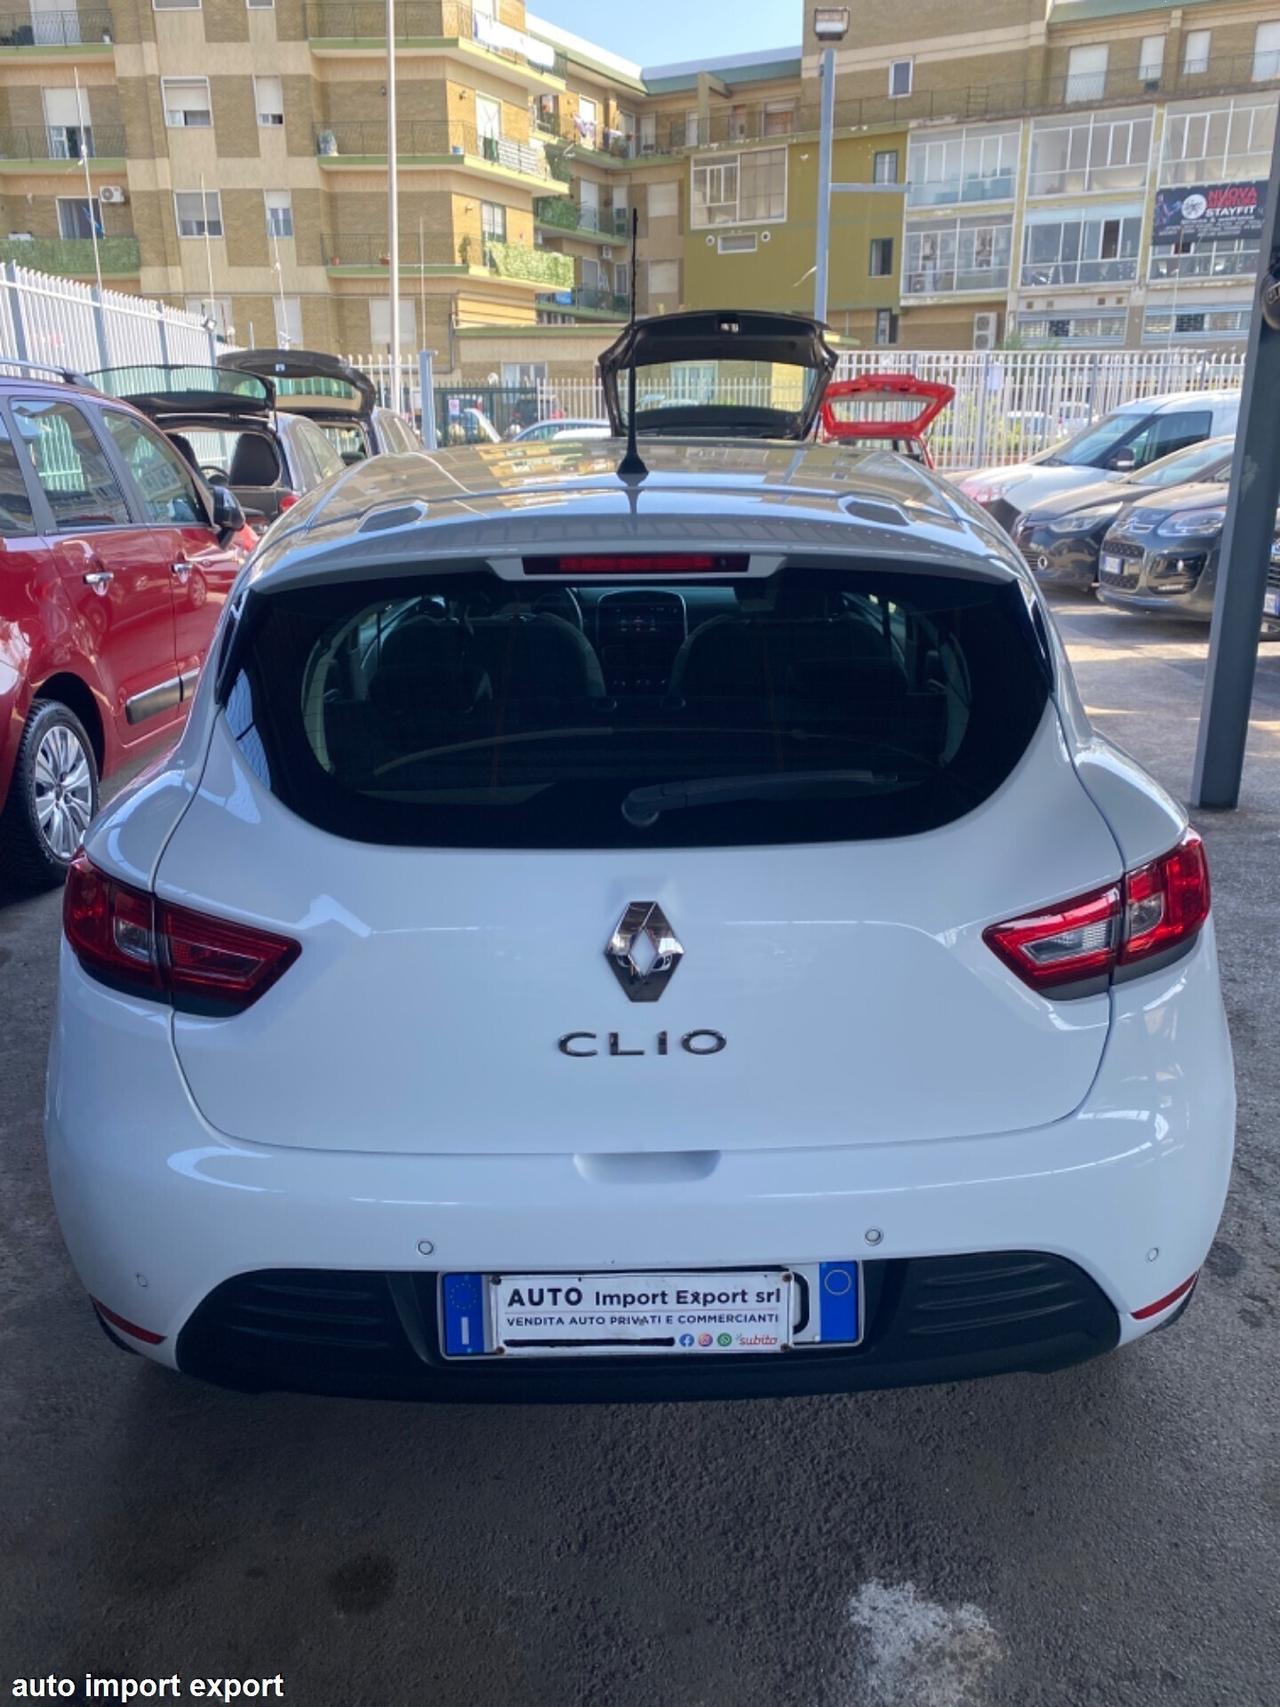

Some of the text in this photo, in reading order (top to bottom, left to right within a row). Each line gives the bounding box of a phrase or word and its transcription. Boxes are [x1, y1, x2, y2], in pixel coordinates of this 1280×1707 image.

[1208, 187, 1257, 201] NUOVA
[1205, 205, 1257, 218] STAYFIT
[558, 1029, 727, 1057] CLIO
[508, 1287, 781, 1308] AUTO Import Export srl
[506, 1314, 779, 1326] VENDITA AUTO PRIVATI E COMMERCIANTI
[739, 1334, 778, 1346] subito
